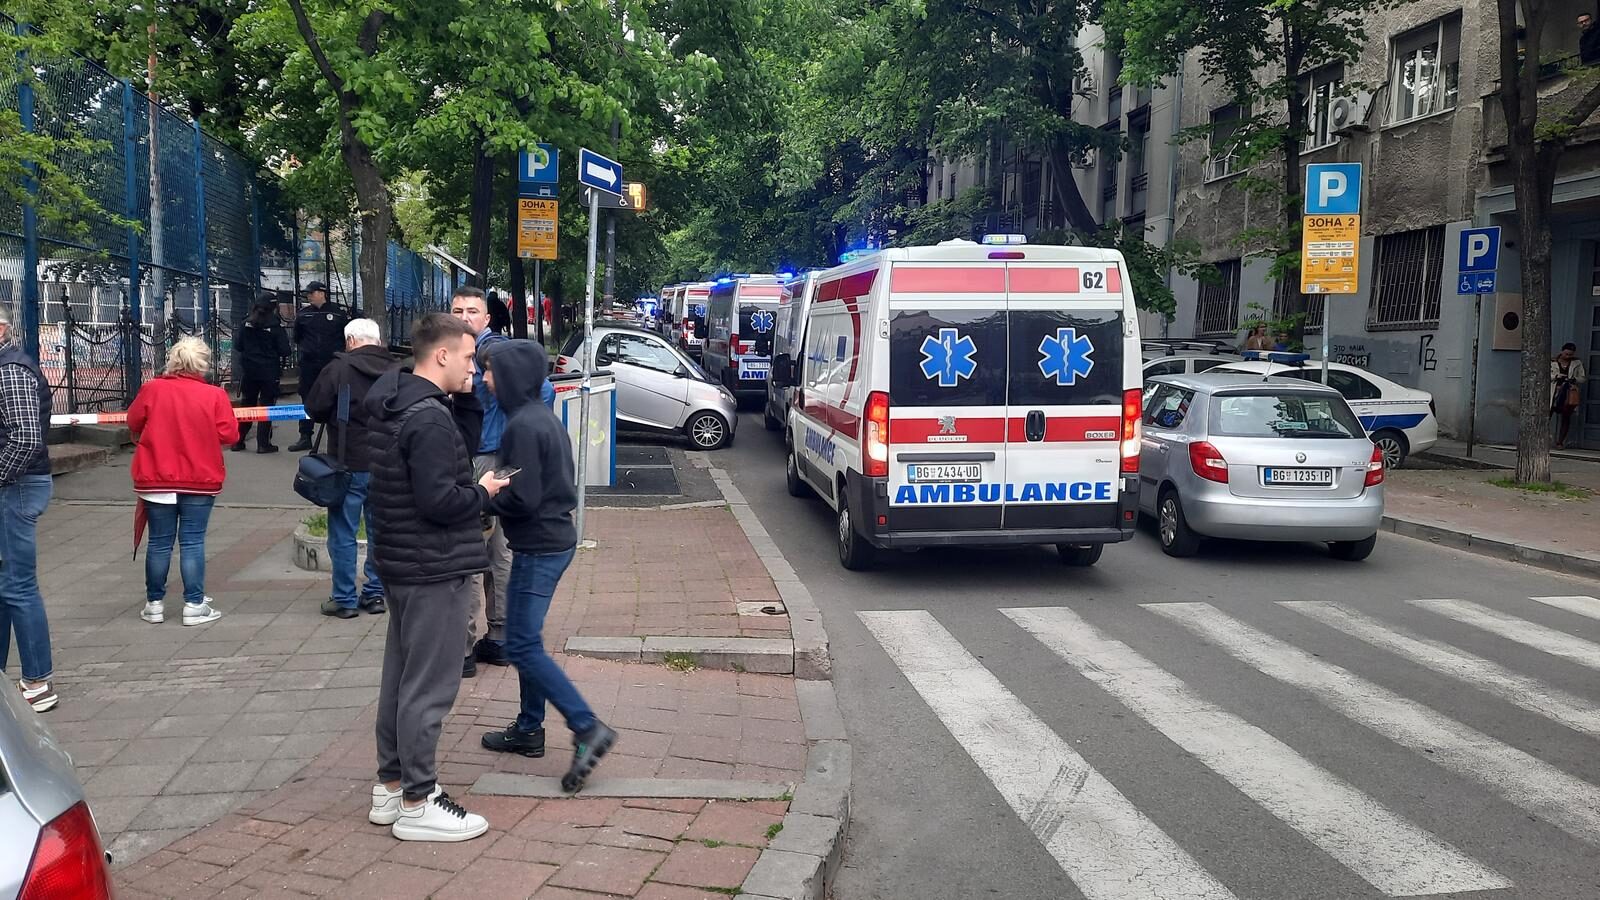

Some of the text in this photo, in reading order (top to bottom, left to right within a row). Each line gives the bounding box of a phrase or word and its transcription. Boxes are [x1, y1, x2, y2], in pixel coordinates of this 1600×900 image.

[527, 149, 550, 178] P
[1318, 171, 1348, 208] P
[521, 200, 546, 209] ЗОНА
[1308, 217, 1355, 228] ЗОНА 2
[1466, 233, 1490, 267] P
[1082, 271, 1104, 289] 62
[916, 466, 930, 478] BG
[1273, 470, 1285, 481] BG
[895, 482, 1111, 504] AMBULANCE
